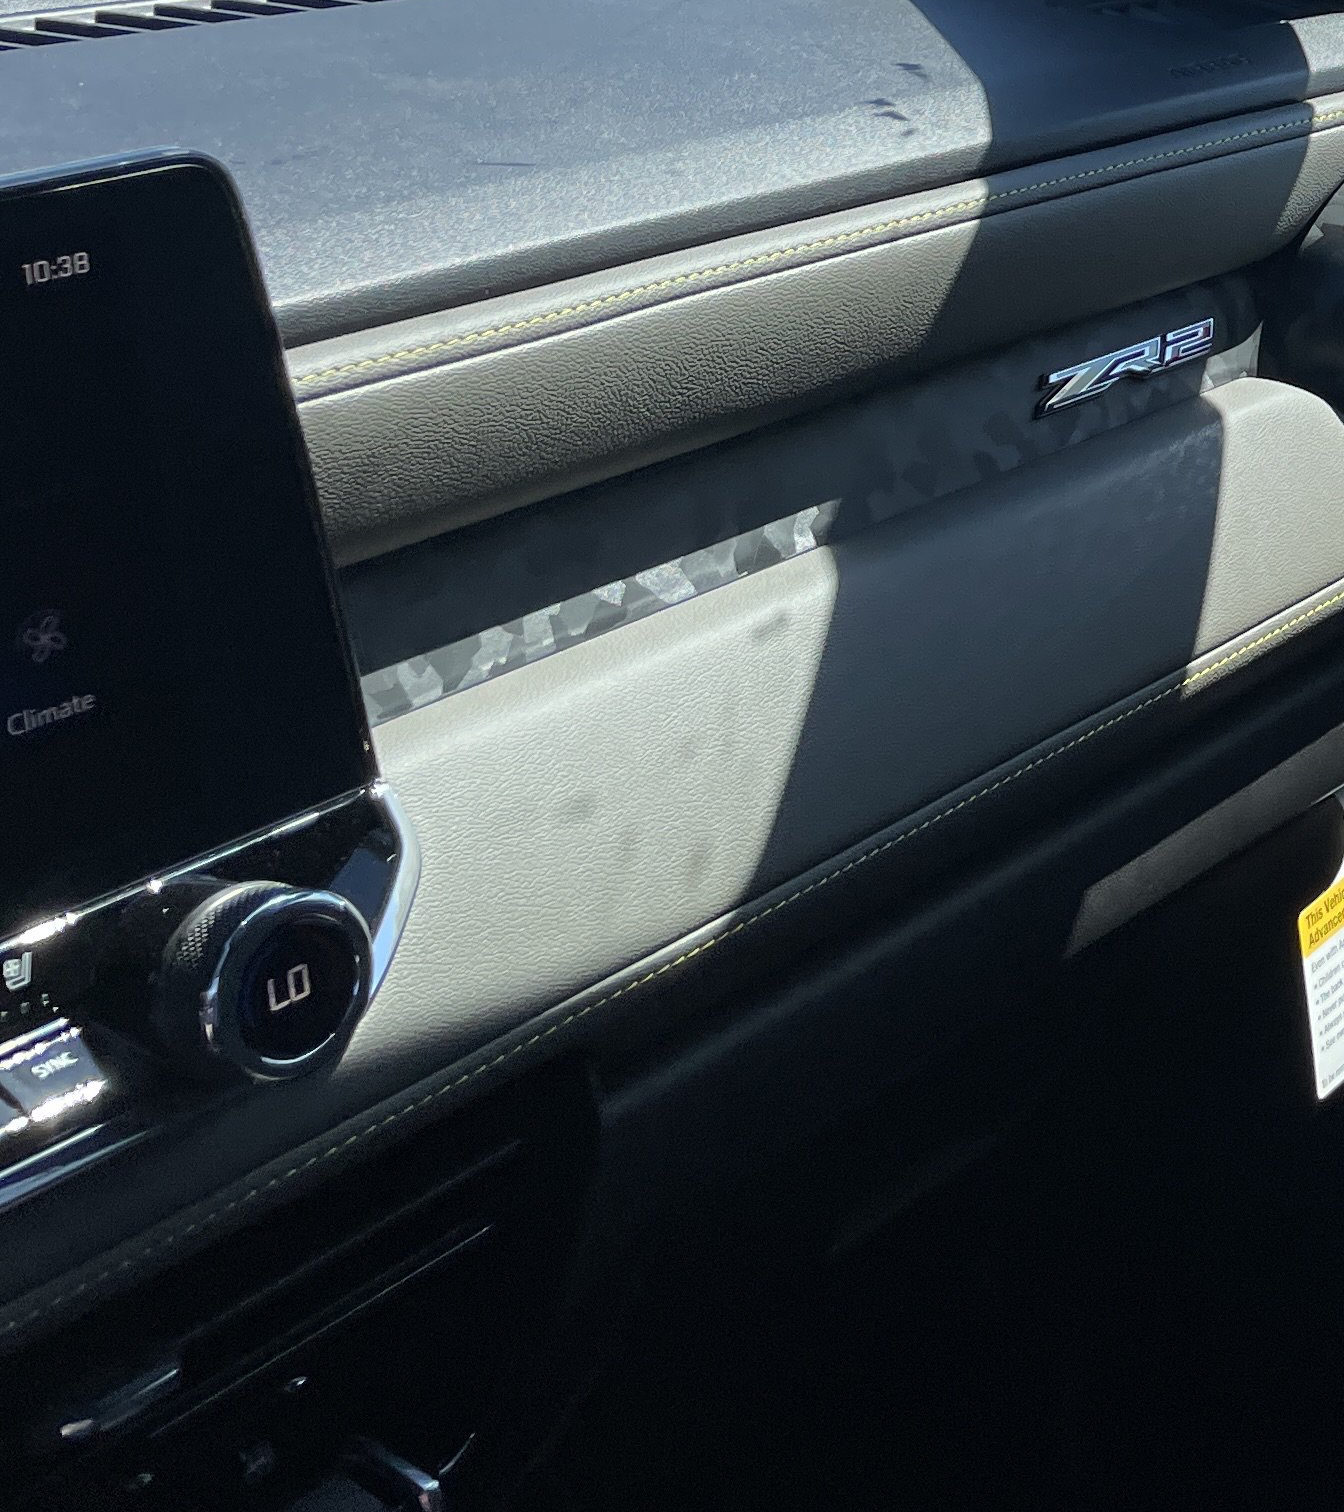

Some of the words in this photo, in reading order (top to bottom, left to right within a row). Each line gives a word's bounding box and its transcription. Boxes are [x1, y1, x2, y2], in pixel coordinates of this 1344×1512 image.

[22, 251, 91, 286] 10:38
[1036, 318, 1214, 416] ZR2
[7, 690, 96, 738] Climate
[1306, 905, 1323, 929] This
[267, 963, 311, 1015] LO
[31, 1050, 79, 1081] SYNC
